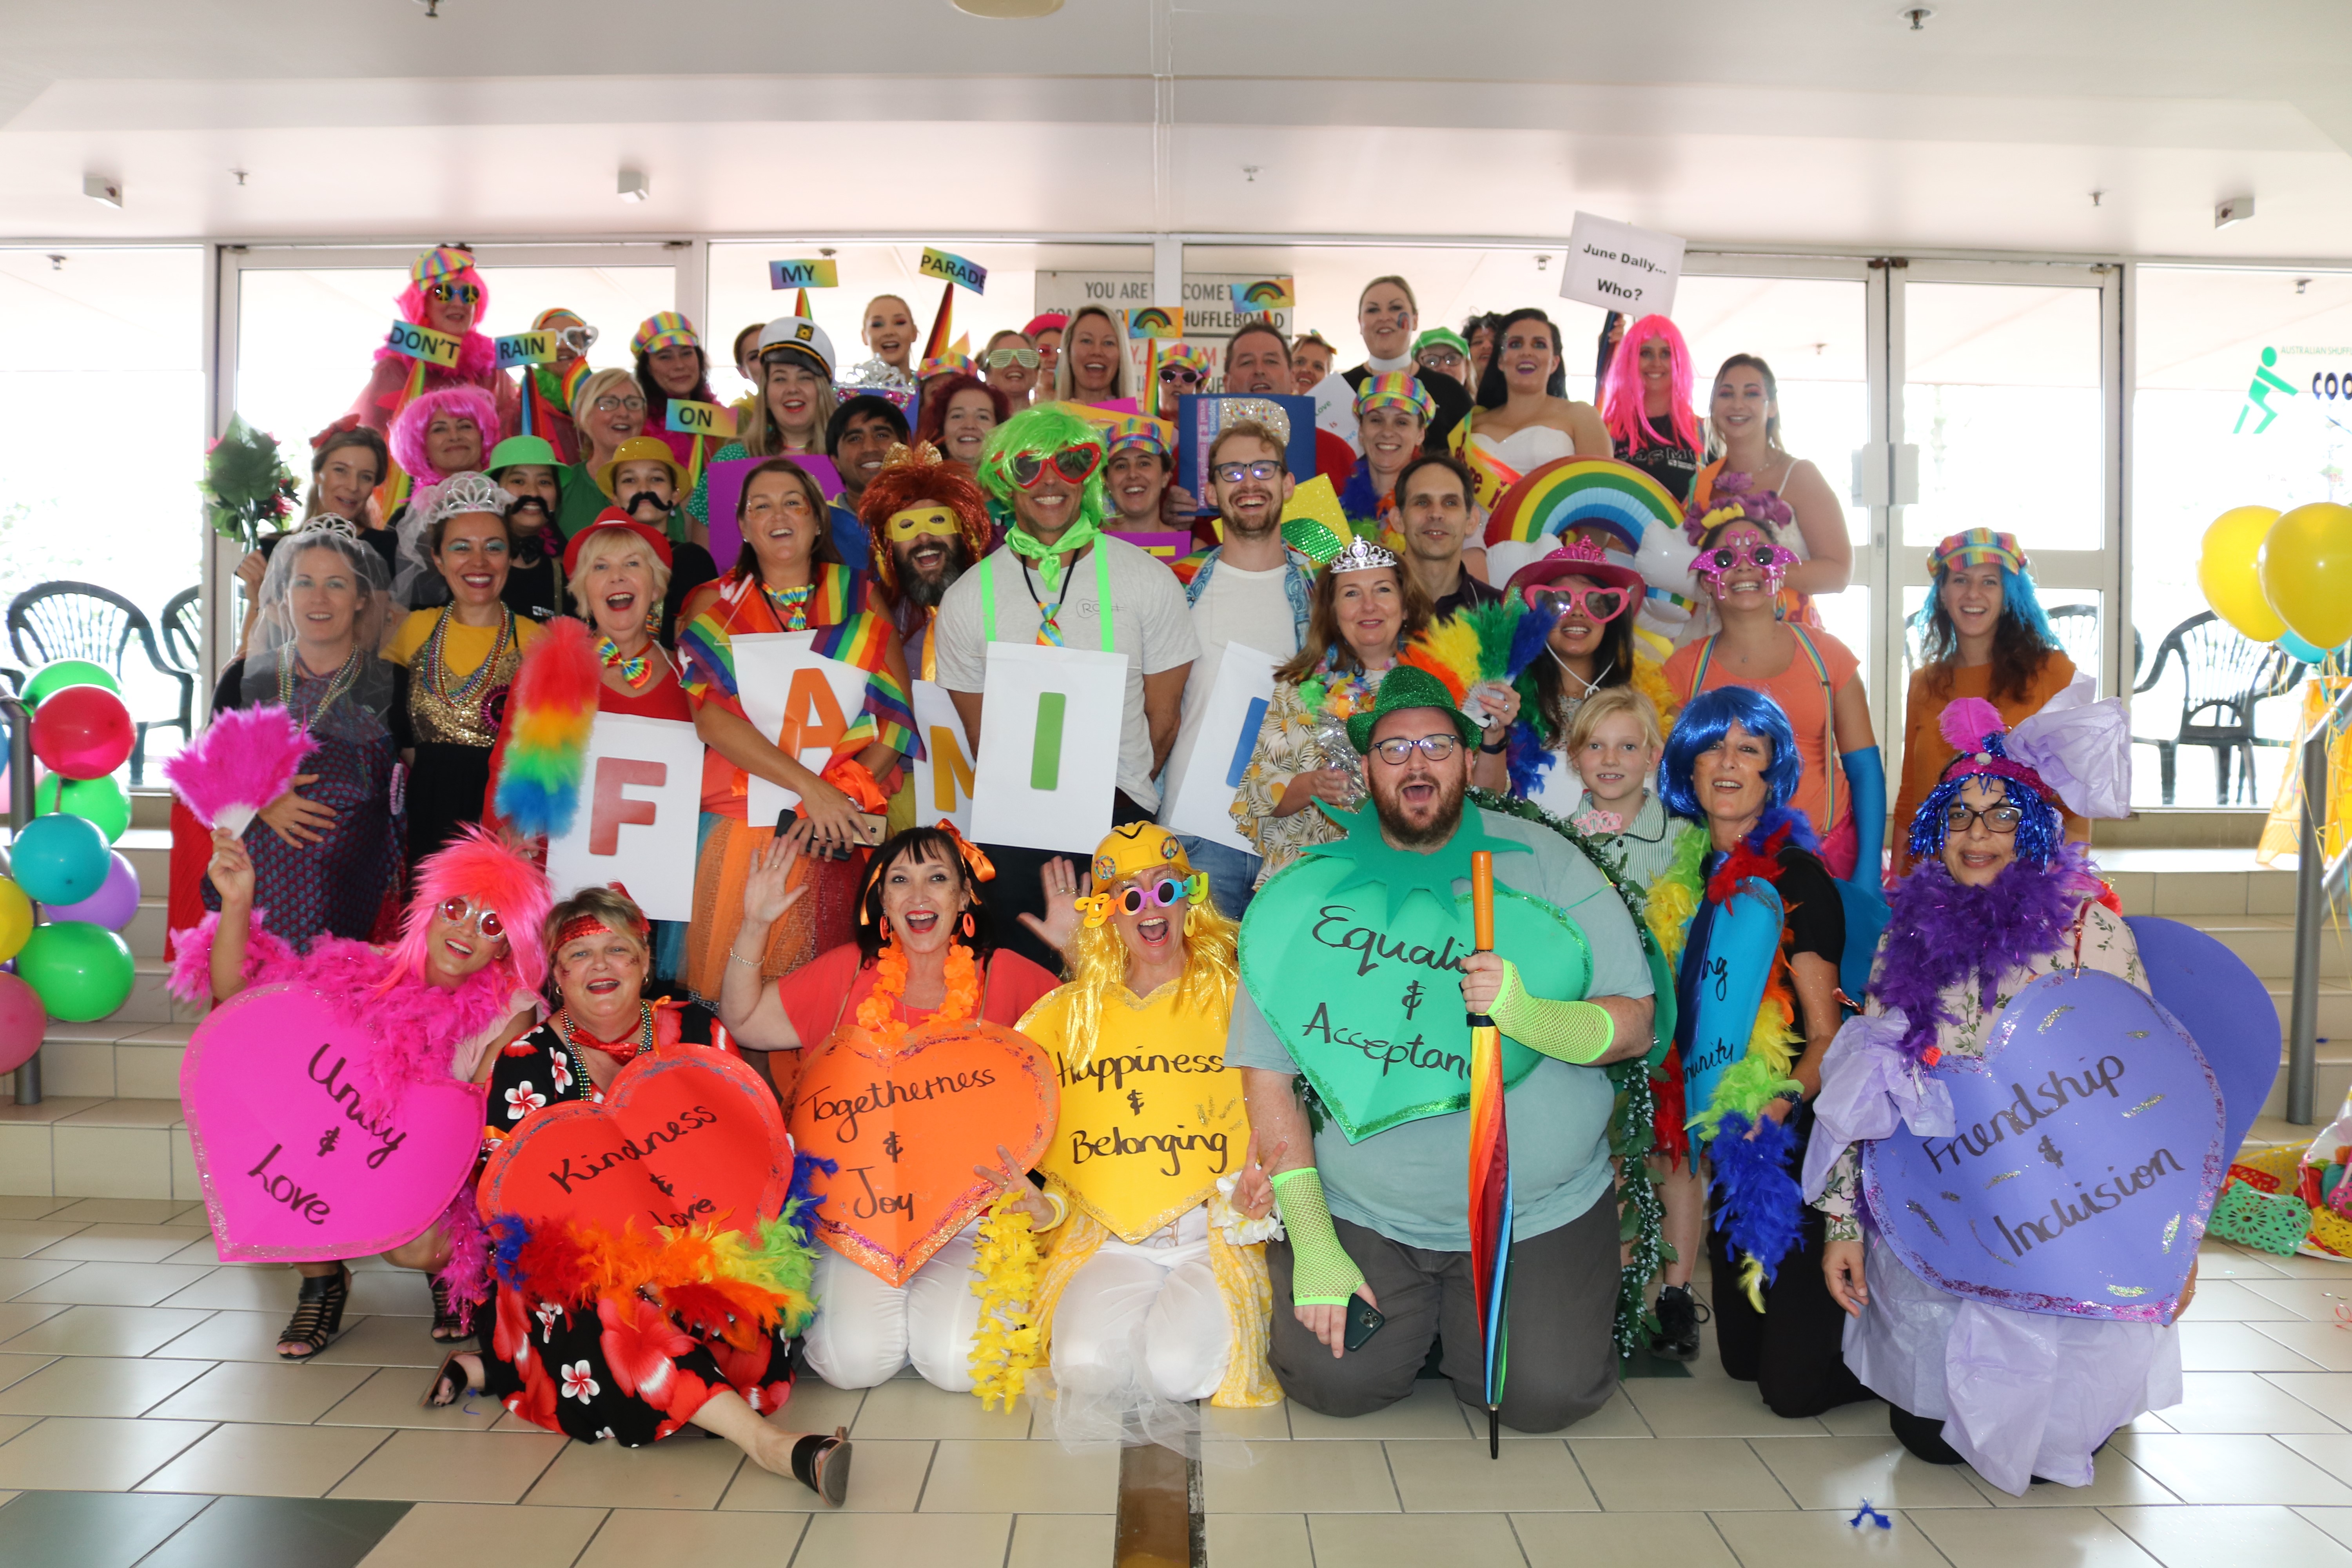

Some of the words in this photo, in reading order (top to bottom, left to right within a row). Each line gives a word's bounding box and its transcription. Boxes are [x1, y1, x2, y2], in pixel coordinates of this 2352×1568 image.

[781, 265, 815, 283] MY
[921, 254, 986, 289] PARADE
[1584, 244, 1617, 260] June
[1621, 253, 1667, 274] Dally...
[1085, 282, 1114, 298] YOU
[1120, 282, 1147, 299] ARE
[1598, 278, 1642, 300] Who?
[389, 326, 460, 359] DON'T
[500, 336, 545, 360] RAIN
[2281, 346, 2326, 355] AUSTRALIAN
[679, 407, 712, 428] ON
[778, 668, 848, 762] A
[1030, 691, 1066, 790] I
[589, 757, 667, 856] F
[1401, 980, 1426, 1020] &
[1056, 1046, 1225, 1093] Happiness
[800, 1069, 996, 1143] Togetherness
[1127, 1089, 1144, 1116] &
[1922, 1055, 2125, 1174] Friendship
[317, 1126, 341, 1157] &
[548, 1105, 717, 1194] Kindness
[883, 1131, 904, 1163] &
[1069, 1125, 1227, 1176] Belonging
[2038, 1134, 2064, 1169] &
[248, 1144, 330, 1225] Love
[649, 1173, 675, 1198] &
[846, 1166, 914, 1221] Joy
[1993, 1148, 2186, 1258] Inclusion
